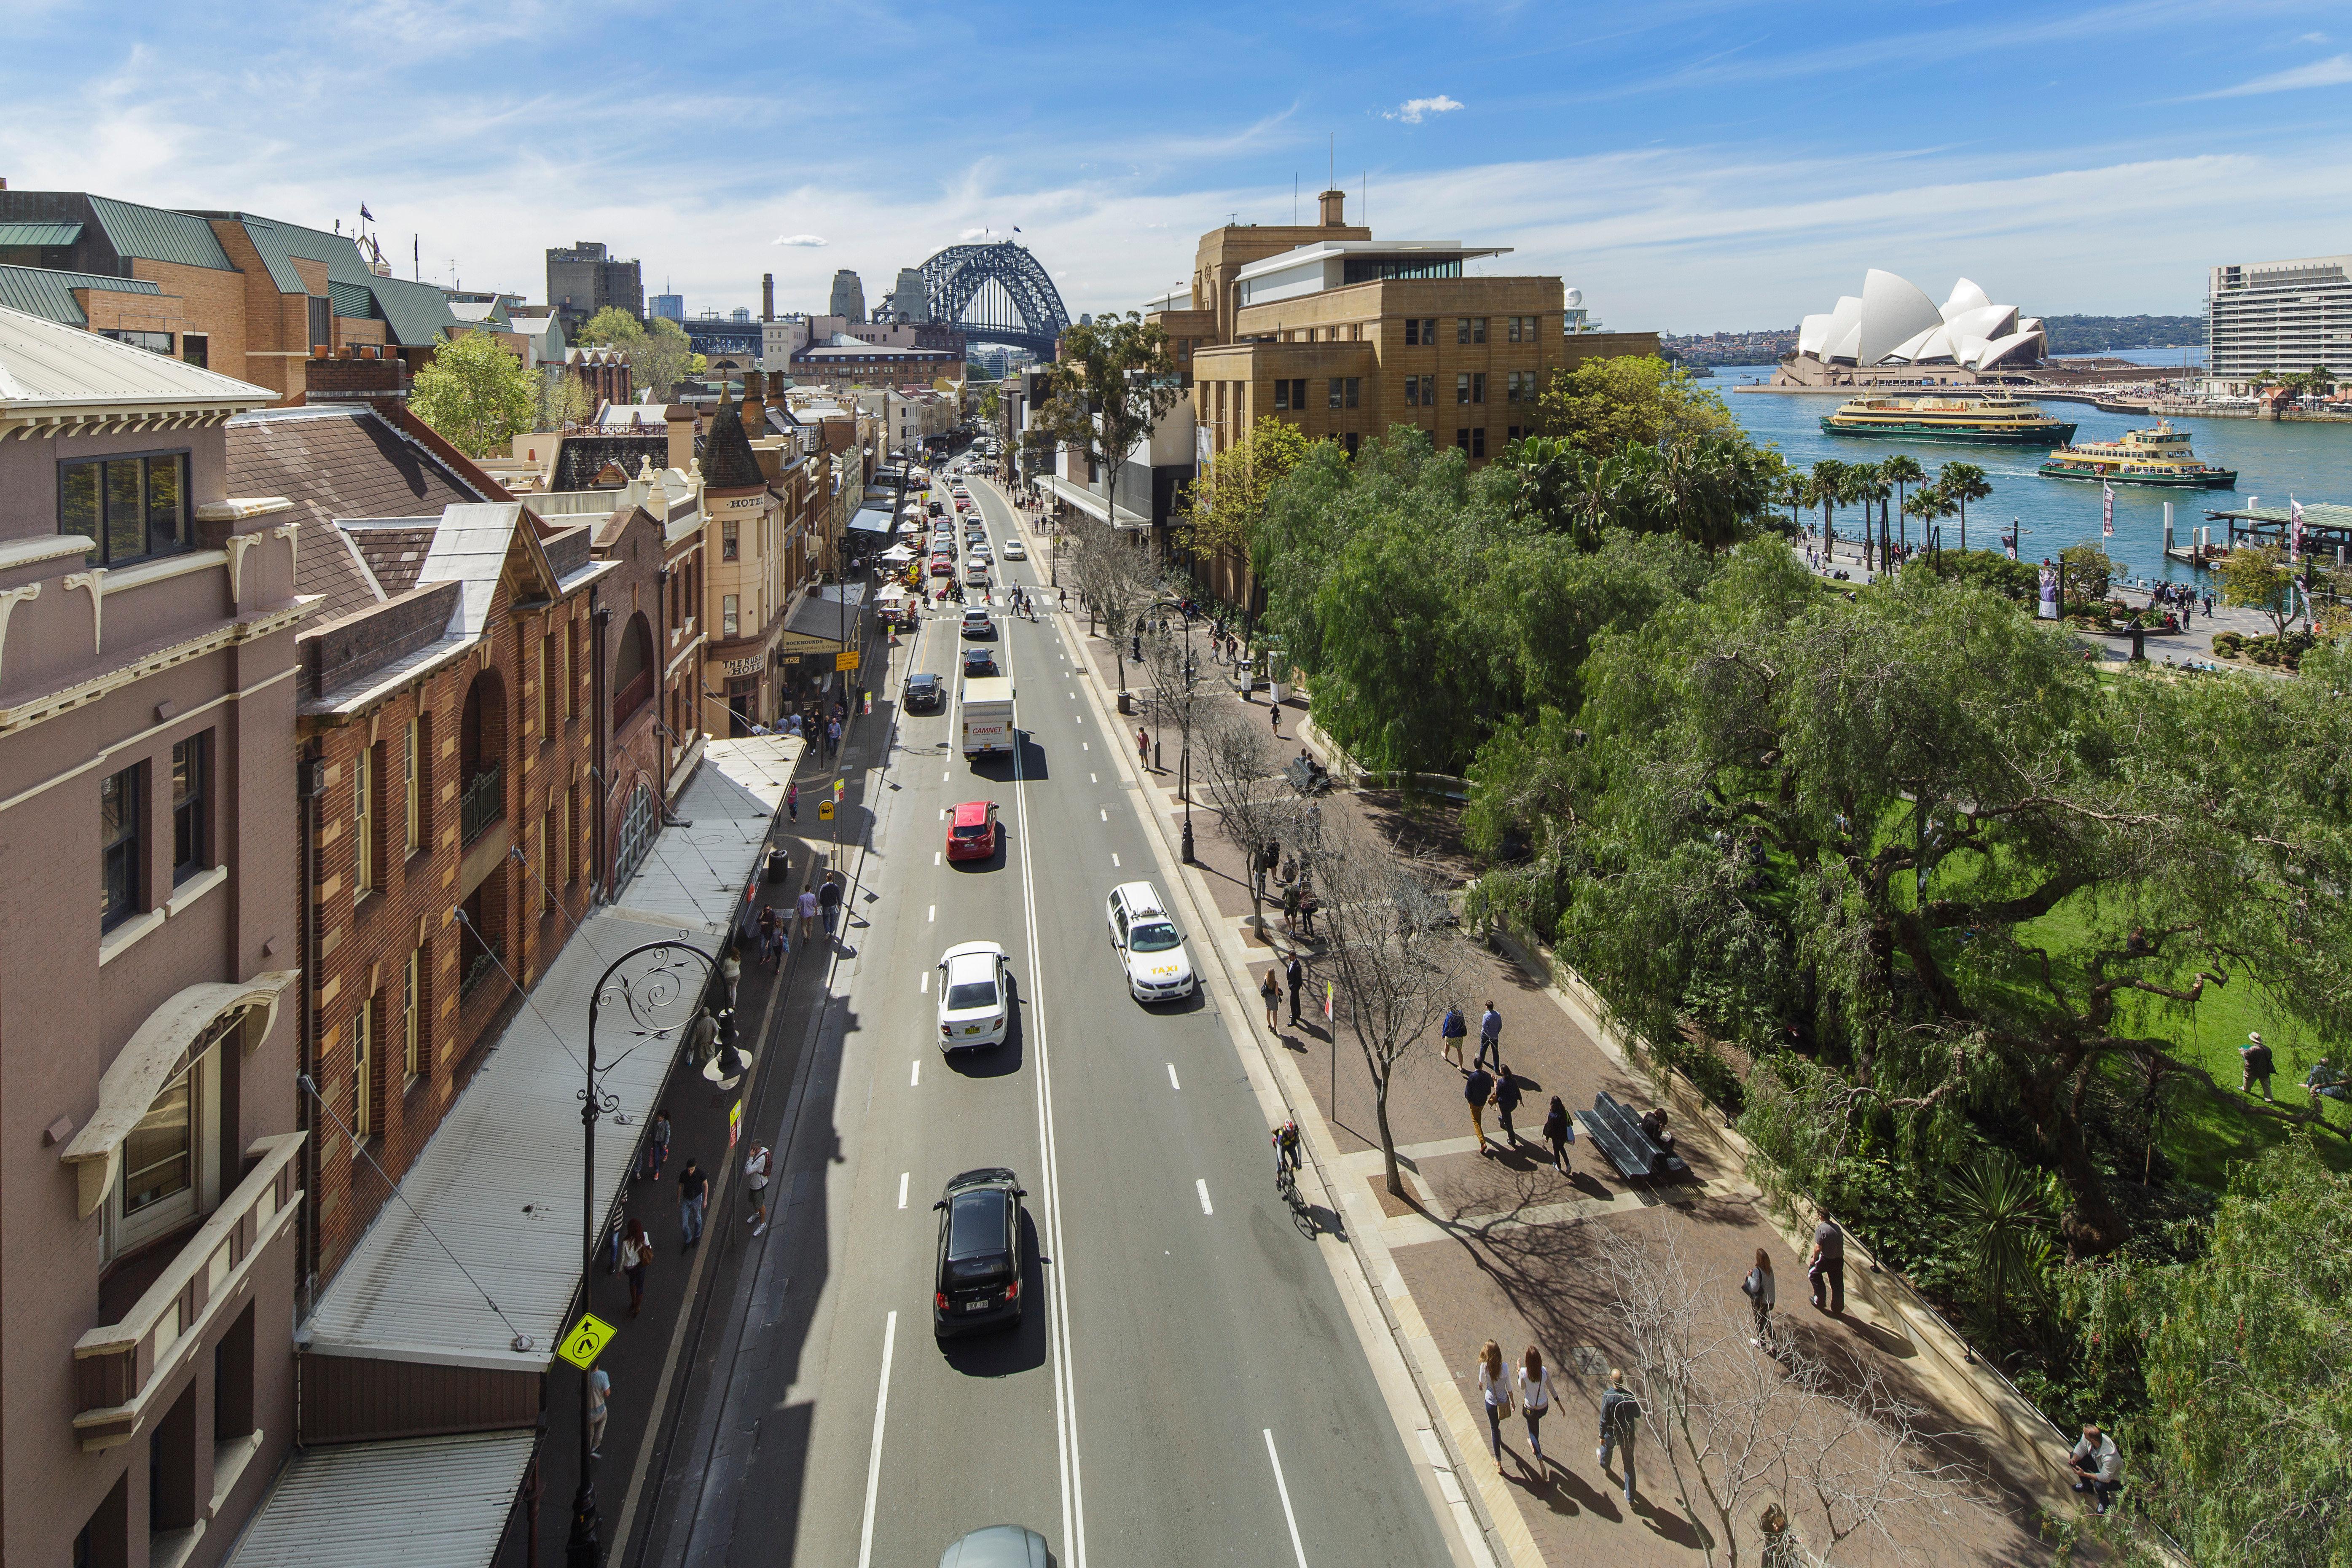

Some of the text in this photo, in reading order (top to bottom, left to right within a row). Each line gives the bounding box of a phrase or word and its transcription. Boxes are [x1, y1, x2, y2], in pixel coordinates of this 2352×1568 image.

[730, 497, 763, 508] HOTEL
[722, 660, 742, 669] THE
[731, 660, 763, 676] HOTEL
[1151, 965, 1178, 975] TAXI
